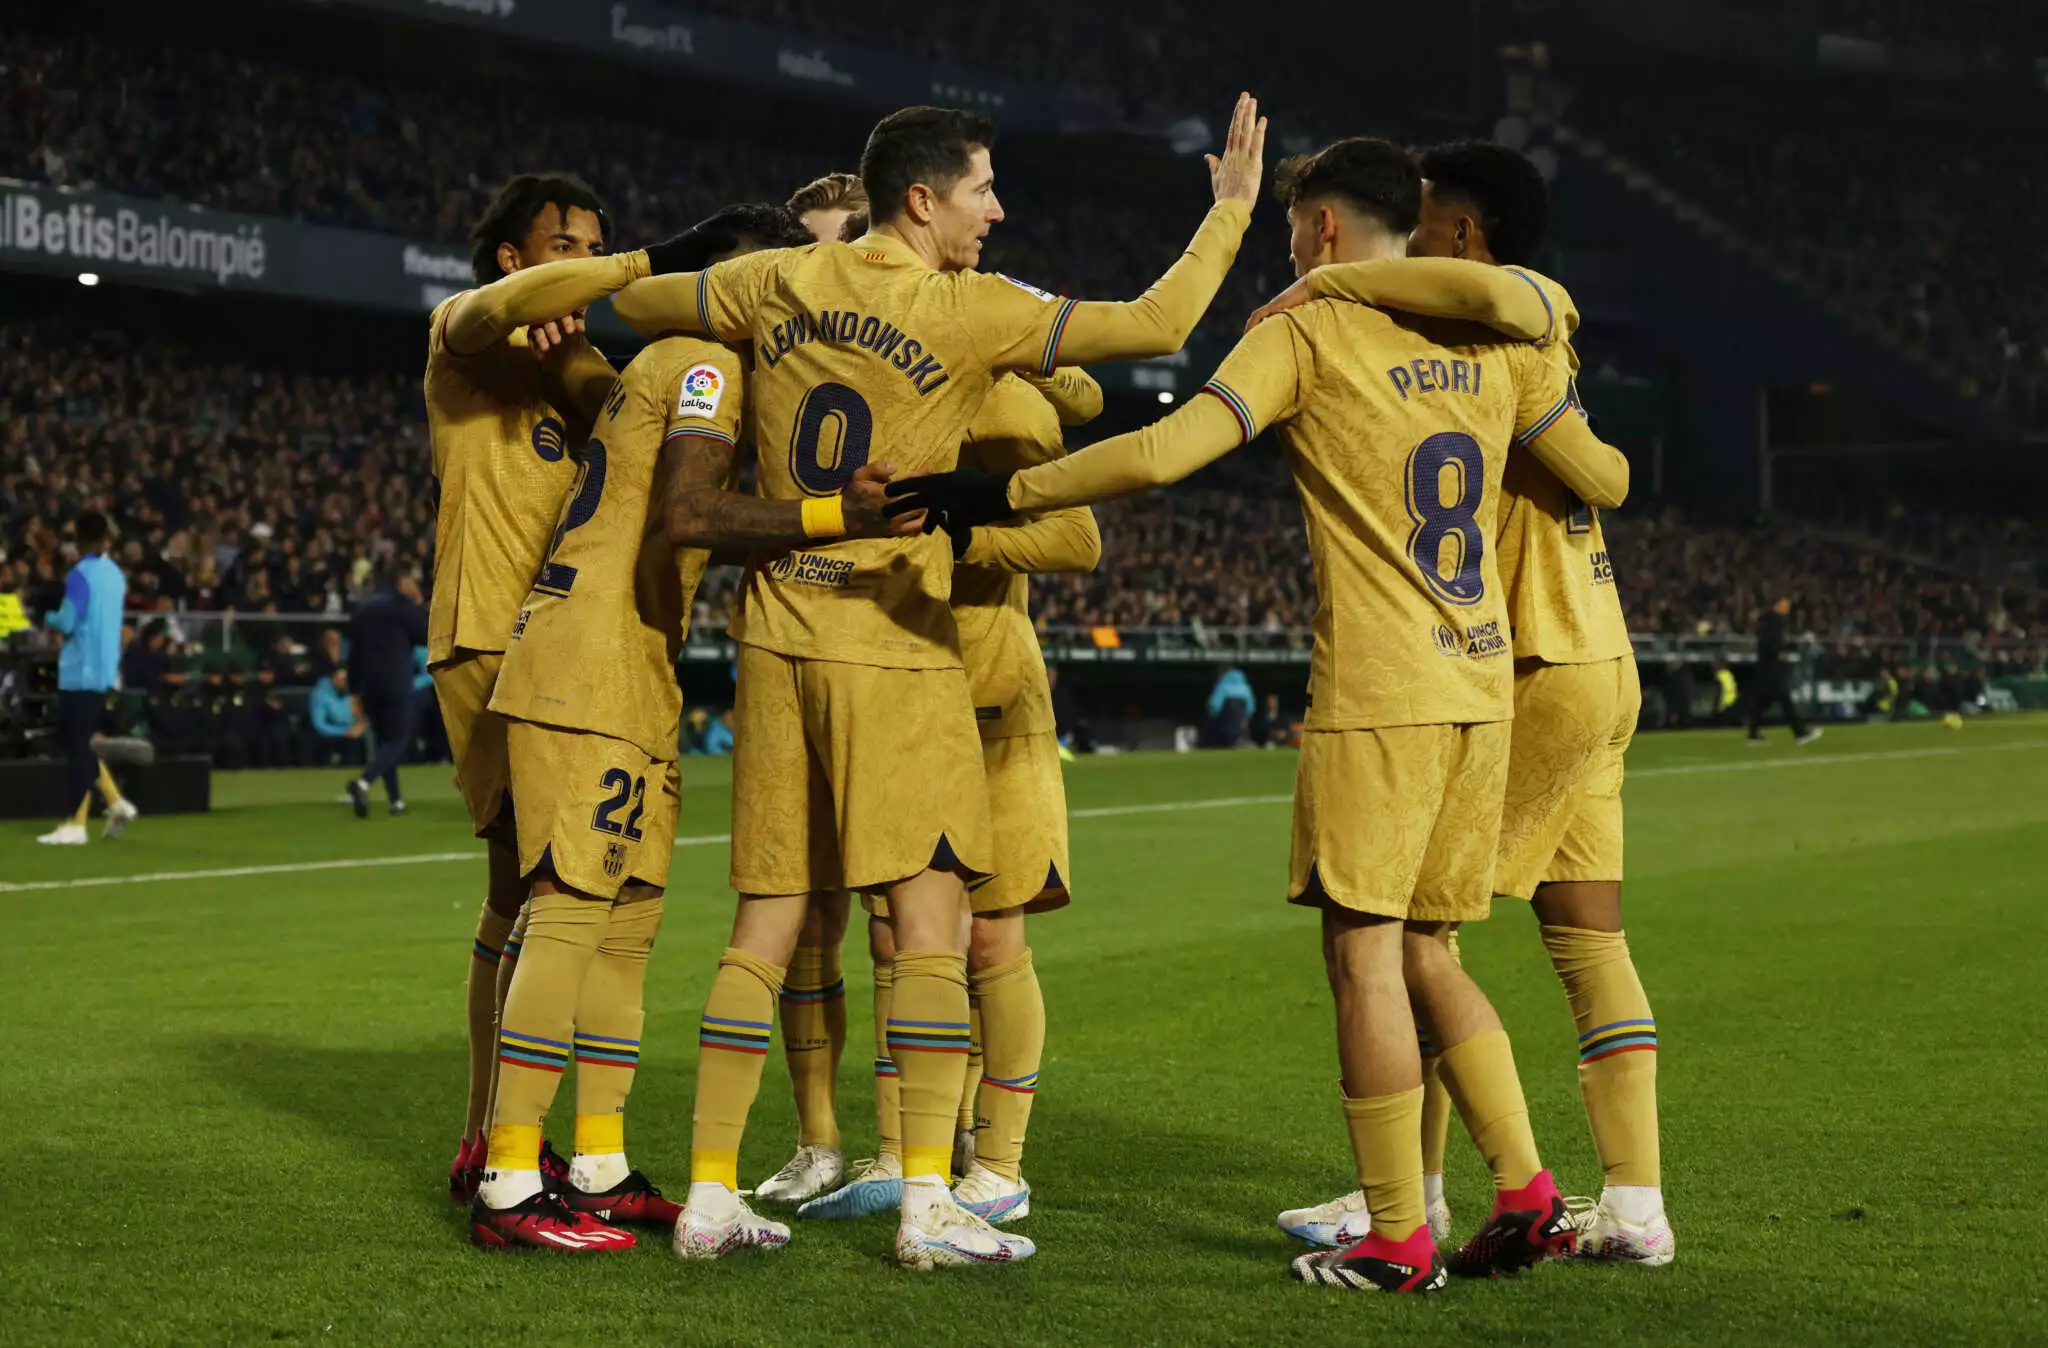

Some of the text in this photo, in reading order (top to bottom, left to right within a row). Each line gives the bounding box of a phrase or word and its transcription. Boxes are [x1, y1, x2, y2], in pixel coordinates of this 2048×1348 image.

[760, 310, 949, 397] LEWANDOWSKI
[1387, 358, 1482, 400] PEDRI
[681, 399, 713, 411] LaLiga
[1404, 431, 1484, 606] 8
[799, 553, 855, 572] UNHCR
[794, 566, 850, 585] ACNUR
[1467, 621, 1500, 640] UNHCR
[1467, 635, 1506, 654] ACNUR
[590, 767, 647, 842] 22
